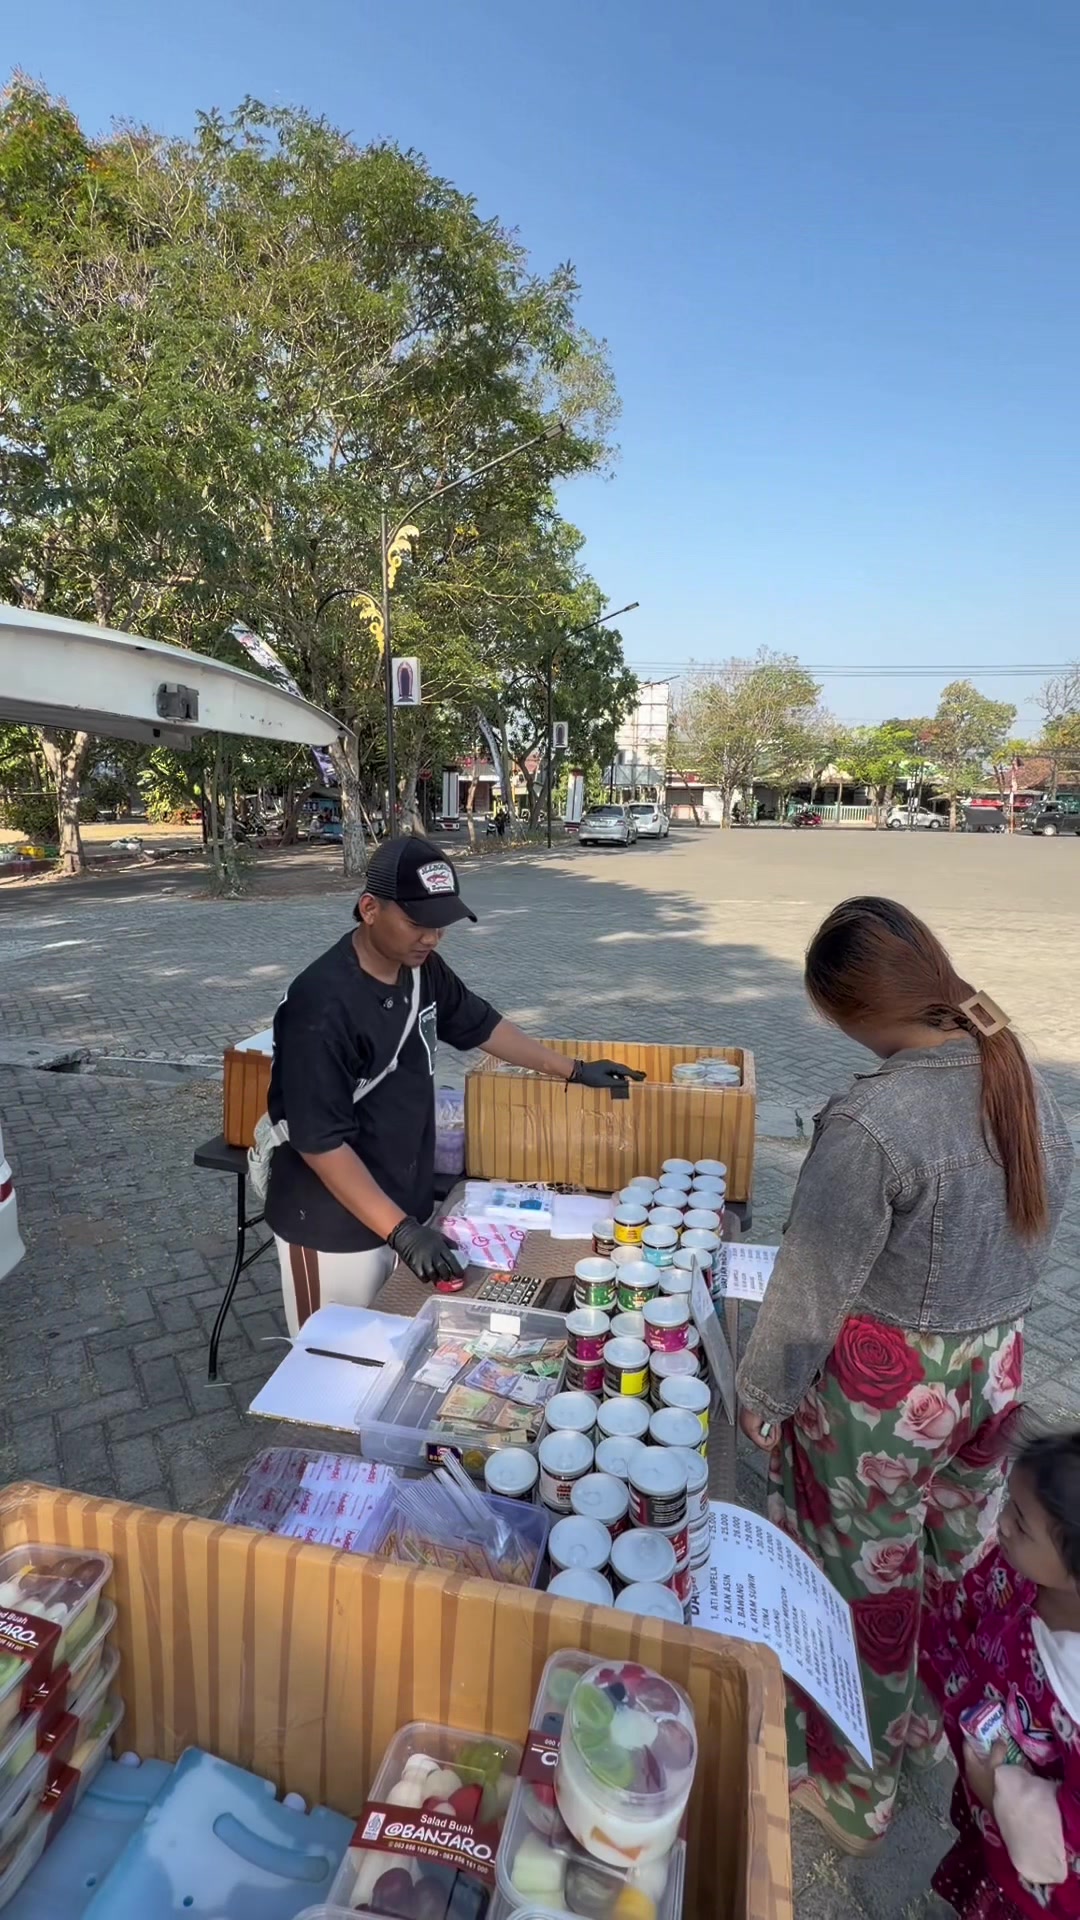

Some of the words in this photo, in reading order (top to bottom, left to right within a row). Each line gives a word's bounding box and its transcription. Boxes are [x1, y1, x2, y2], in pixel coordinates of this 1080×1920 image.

[710, 1566, 718, 1598] AMPELA
[723, 1573, 731, 1593] ASIN
[747, 1573, 757, 1600] SUWIR
[710, 1598, 719, 1611] ATI
[723, 1593, 733, 1615] IKAN
[735, 1582, 746, 1618] BAWANG
[749, 1599, 759, 1625] AYAM
[761, 1607, 771, 1630] TUNA
[420, 1814, 447, 1828] Salad
[448, 1820, 474, 1836] Buah
